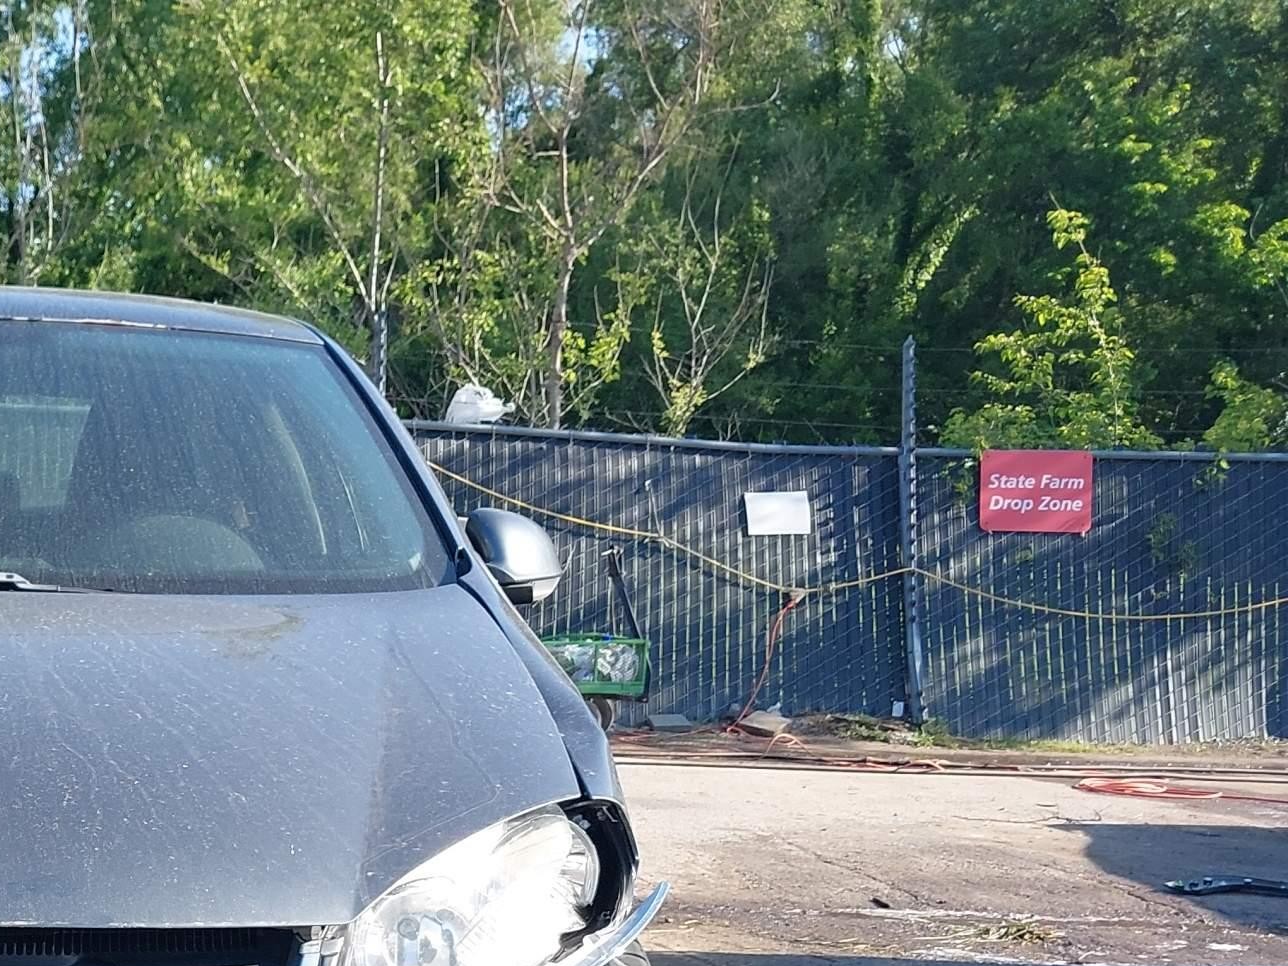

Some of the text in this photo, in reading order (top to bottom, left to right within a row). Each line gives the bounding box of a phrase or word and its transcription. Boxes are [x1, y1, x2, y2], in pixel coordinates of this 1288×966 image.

[988, 473, 1085, 490] State Farm
[989, 495, 1083, 514] Drop Zone
